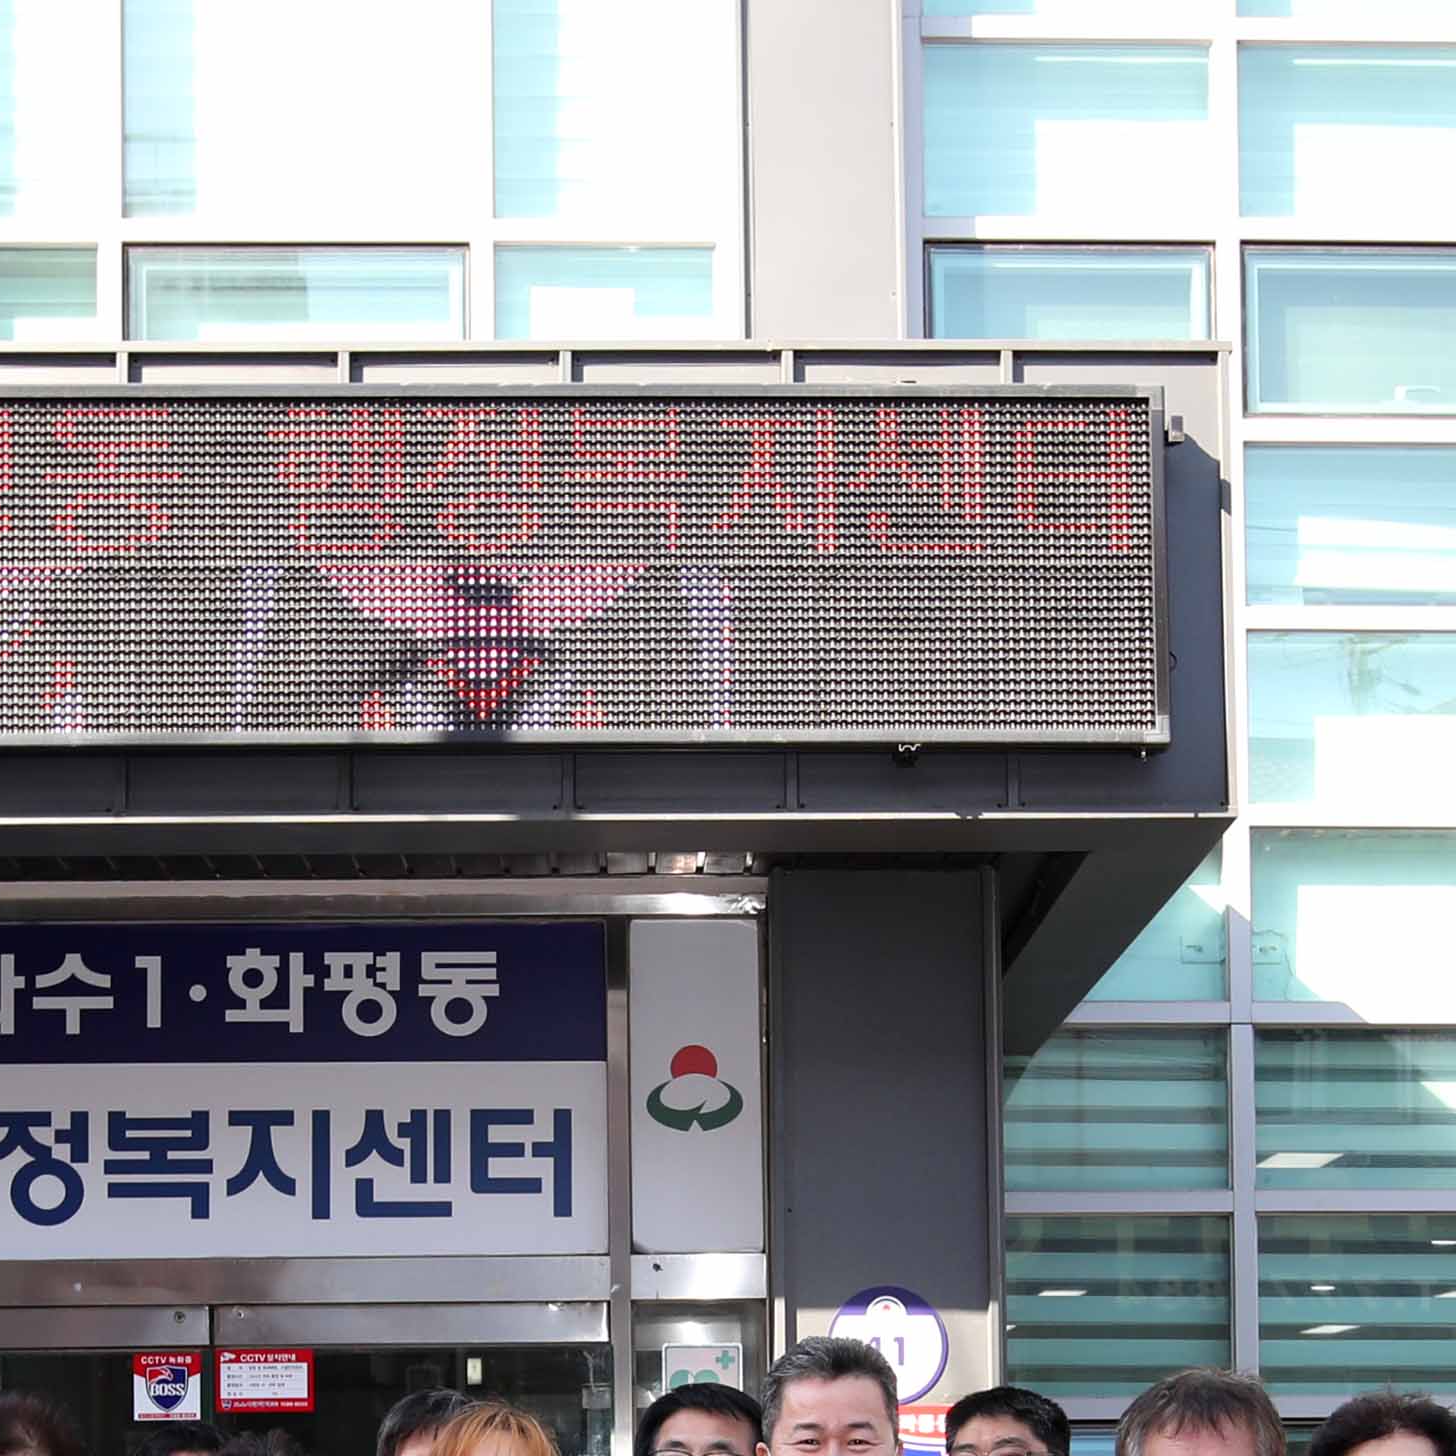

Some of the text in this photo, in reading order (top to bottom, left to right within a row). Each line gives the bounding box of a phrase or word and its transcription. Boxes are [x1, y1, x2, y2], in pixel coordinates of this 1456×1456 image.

[141, 1356, 167, 1365] CCTV
[240, 1353, 265, 1362] CCTV
[150, 1383, 185, 1396] BOSS
